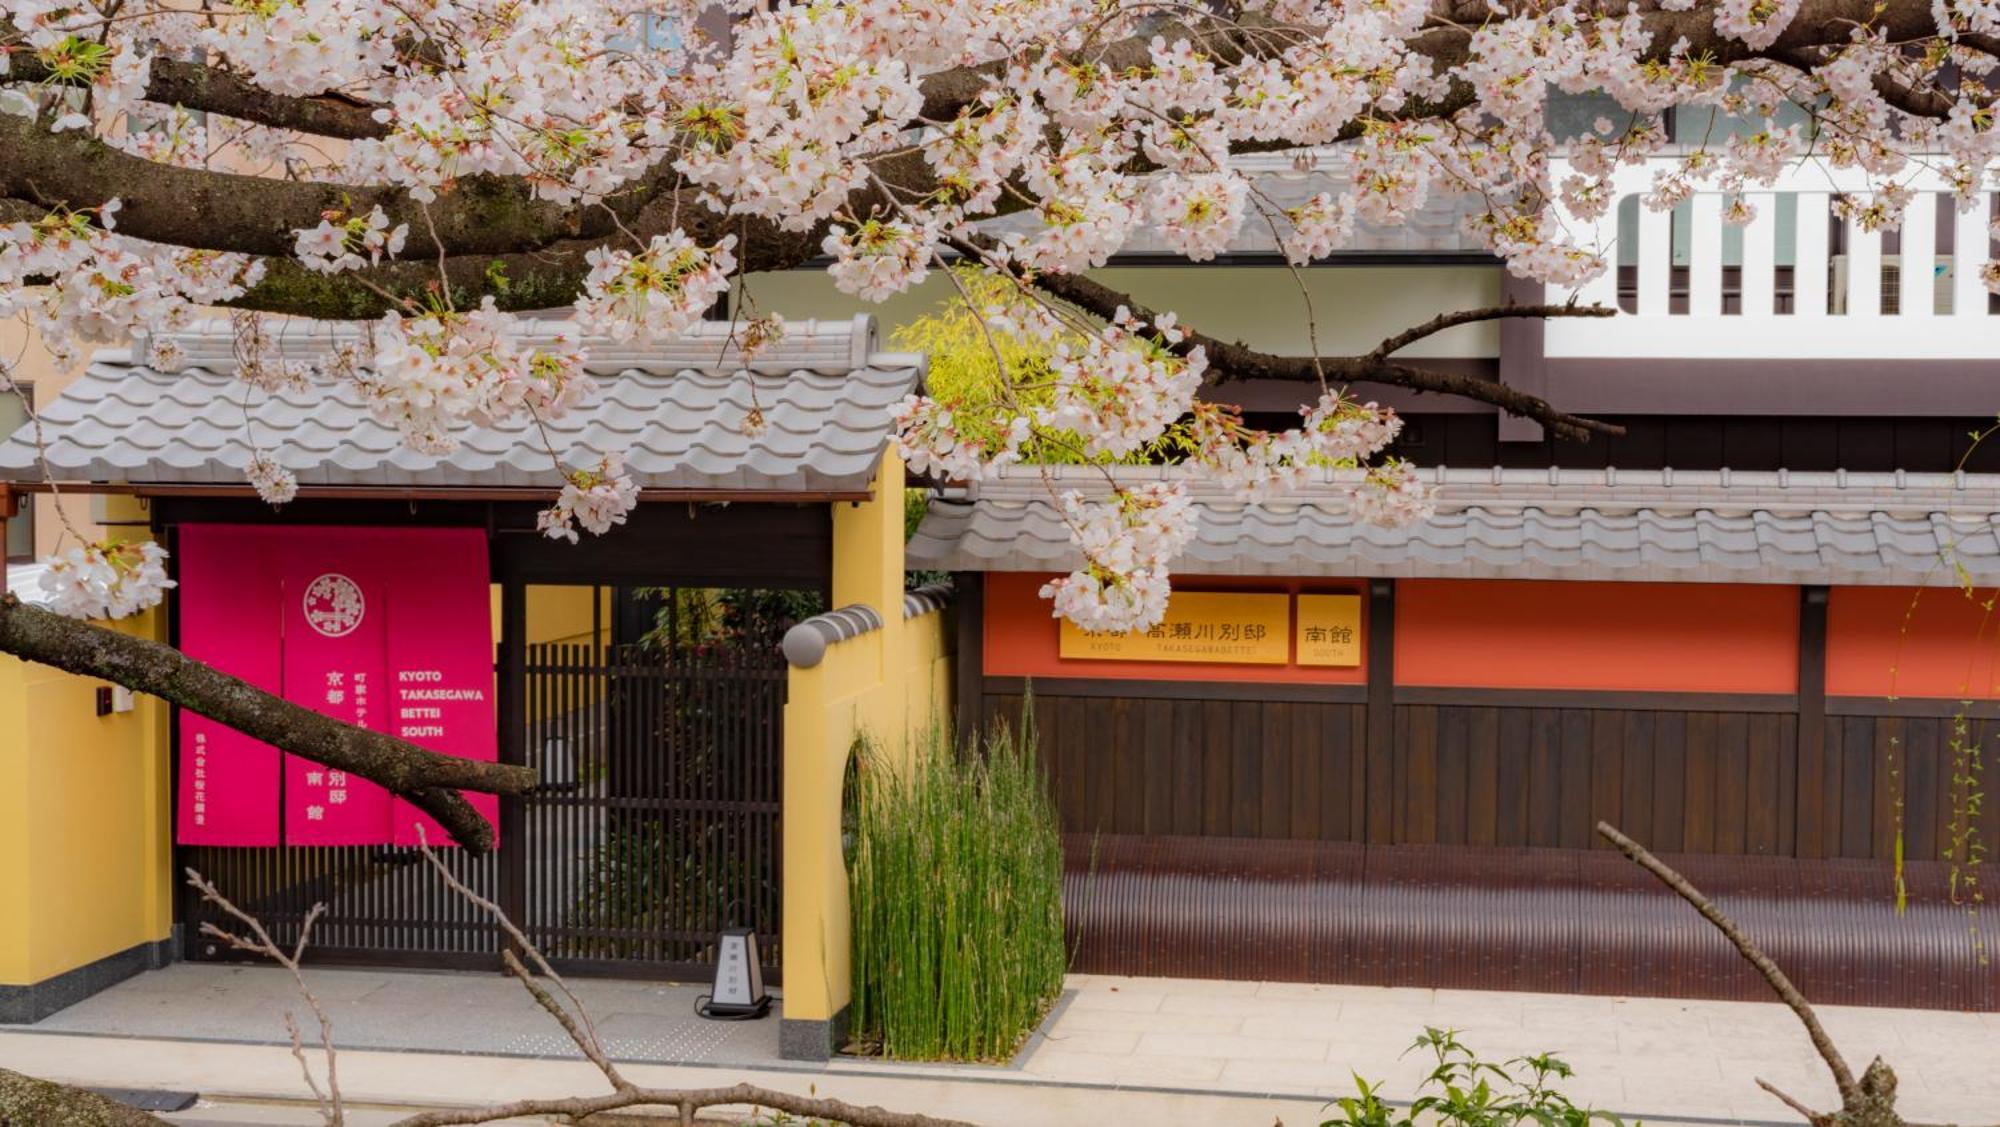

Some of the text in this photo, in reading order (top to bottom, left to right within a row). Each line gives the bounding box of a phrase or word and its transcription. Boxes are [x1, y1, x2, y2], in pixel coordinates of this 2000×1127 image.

[1304, 625, 1353, 643] 南館
[399, 671, 442, 682] KYOTO
[354, 672, 367, 729] 町家ホテル
[400, 689, 484, 701] TAKASEGAWA
[401, 707, 441, 719] BETTEI
[402, 726, 443, 738] SOUTH
